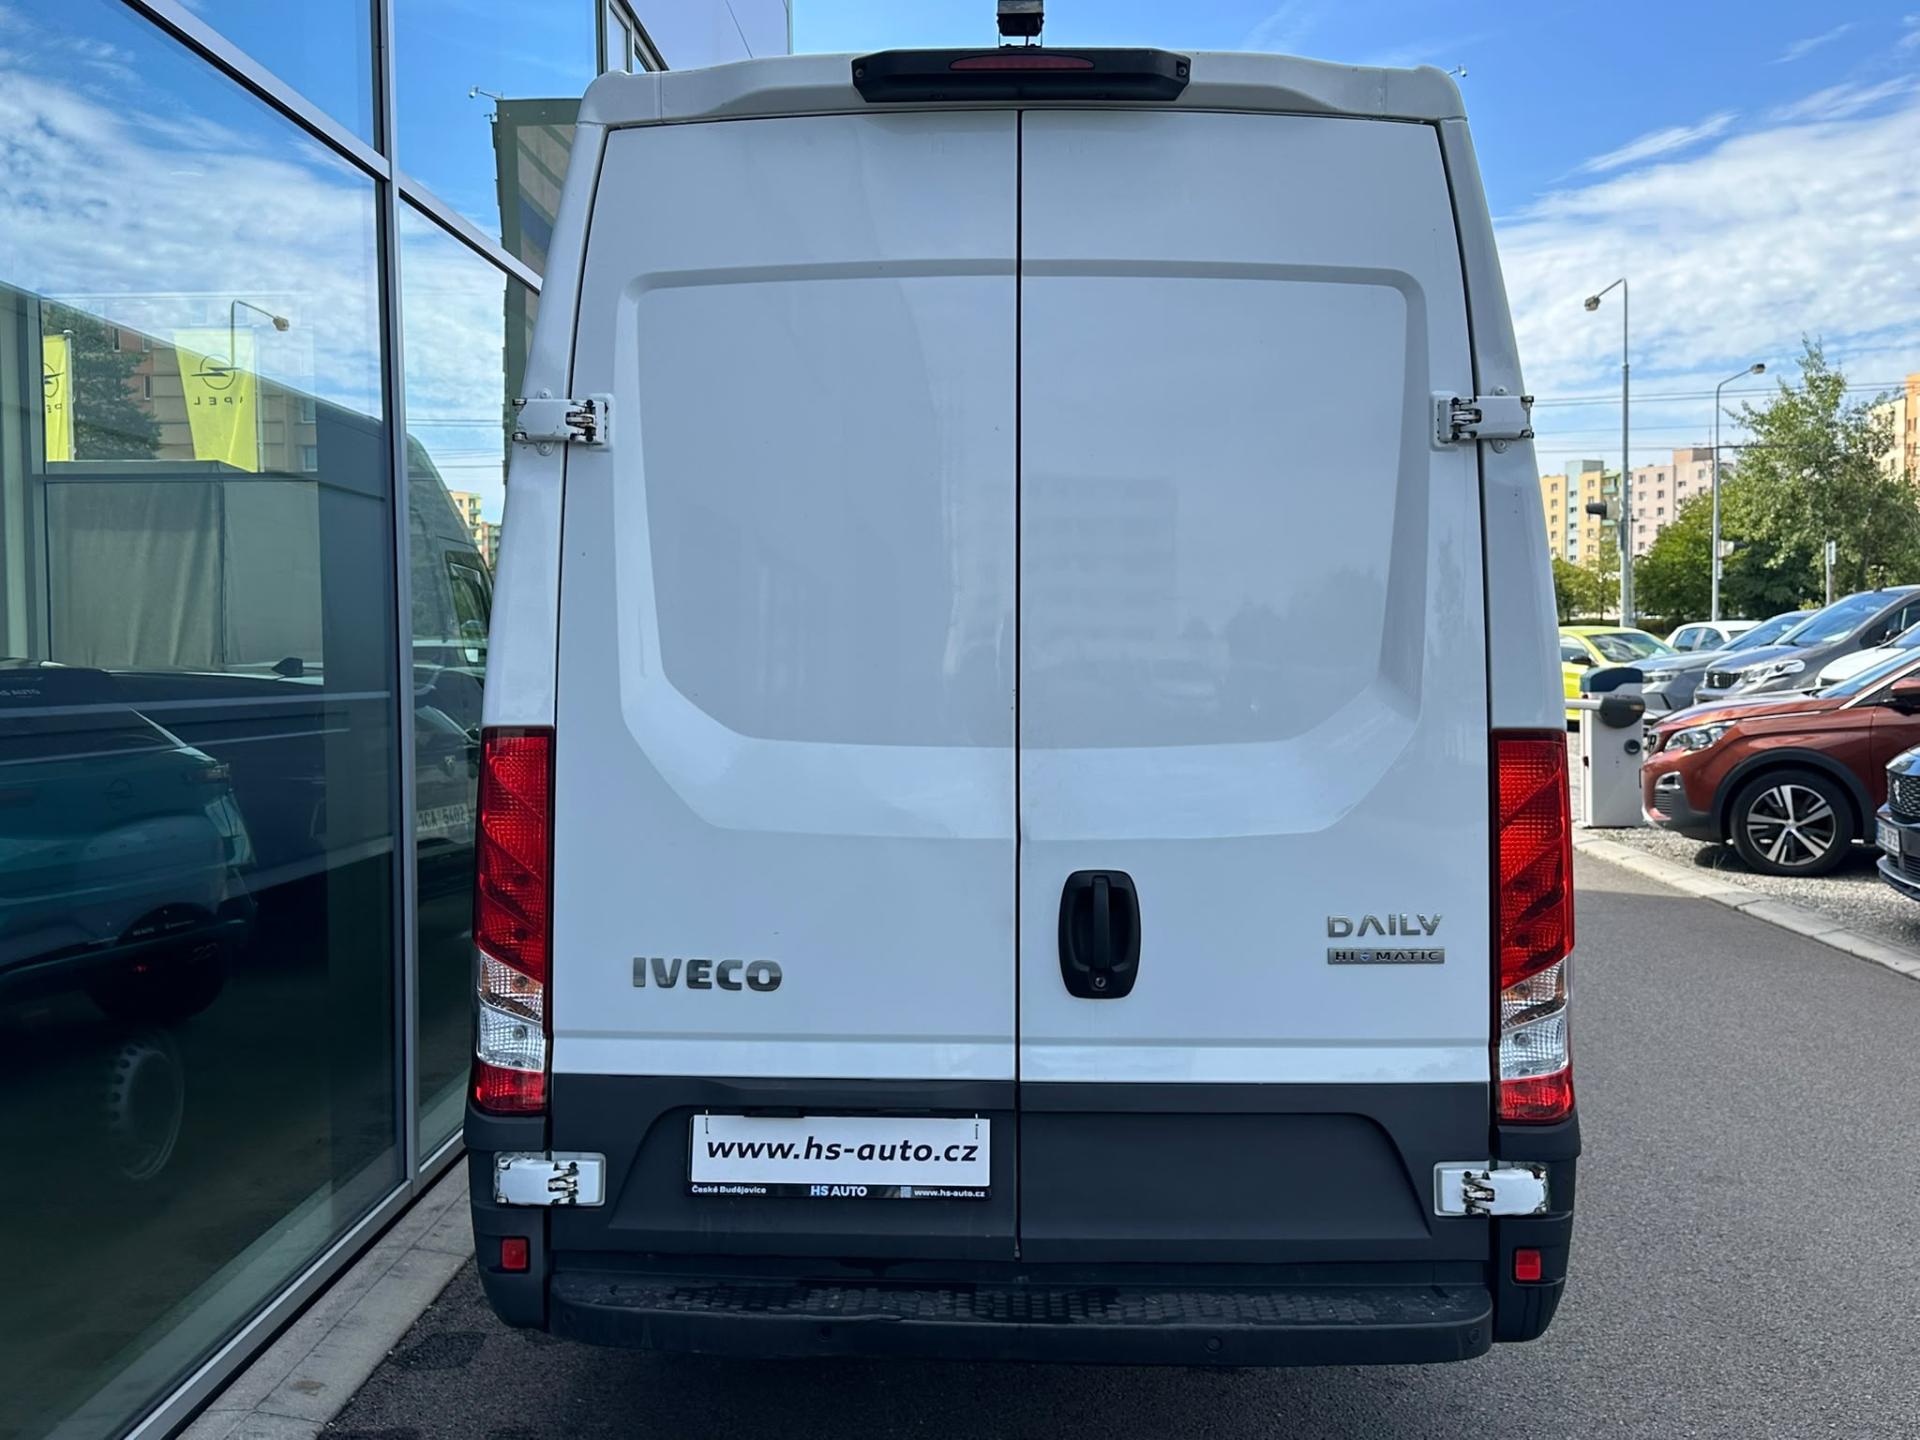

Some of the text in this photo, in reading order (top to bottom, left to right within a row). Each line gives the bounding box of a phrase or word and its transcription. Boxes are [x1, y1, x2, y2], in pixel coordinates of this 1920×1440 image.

[1327, 913, 1442, 938] DAILY
[632, 957, 783, 992] IVECO
[707, 1136, 978, 1162] www.hs-auto.cz
[691, 1185, 767, 1195] České Budějovice
[810, 1185, 868, 1197] HS AUTO
[914, 1189, 985, 1198] www.hs-auto.cz
